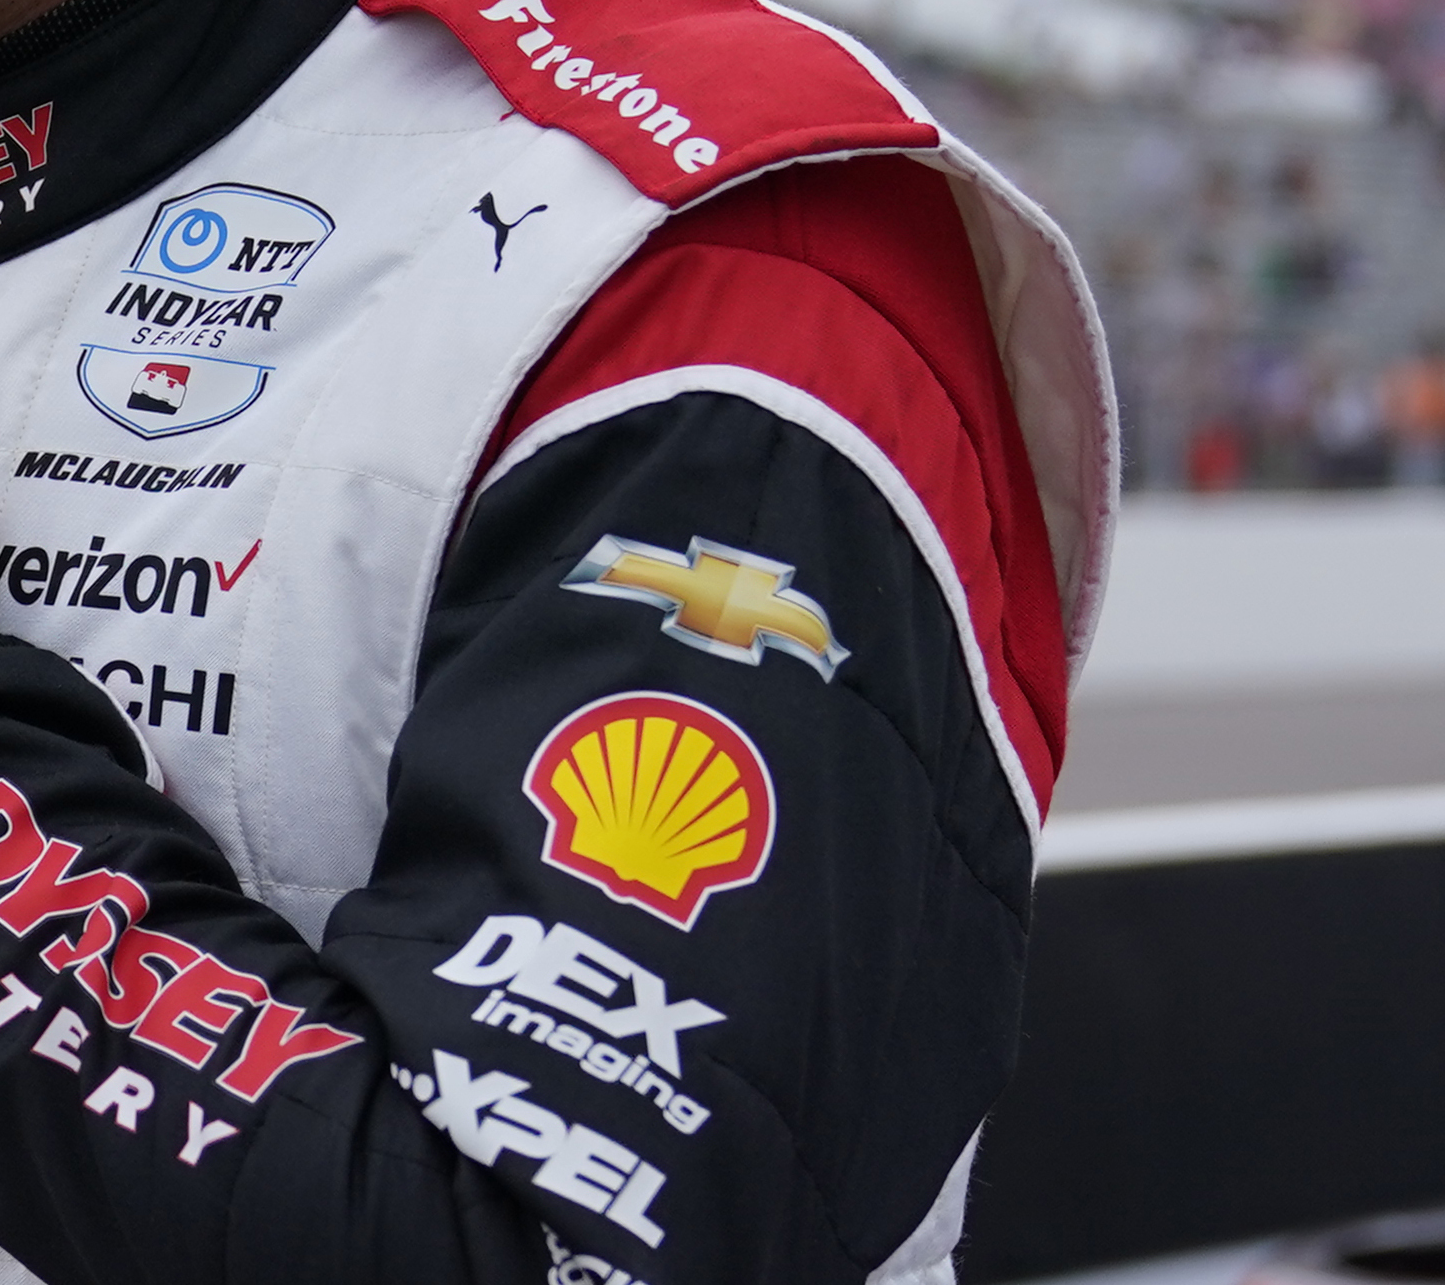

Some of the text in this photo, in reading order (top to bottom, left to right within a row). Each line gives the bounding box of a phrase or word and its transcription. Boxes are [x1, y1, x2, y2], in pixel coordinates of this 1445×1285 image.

[228, 236, 316, 273] NTT
[105, 282, 283, 332] INDYCAR
[131, 326, 227, 349] SERIES
[14, 451, 247, 494] MCLAUGHLIN
[432, 914, 728, 1080] DEX
[471, 989, 711, 1135] imaging
[421, 1047, 668, 1250] XPEL
